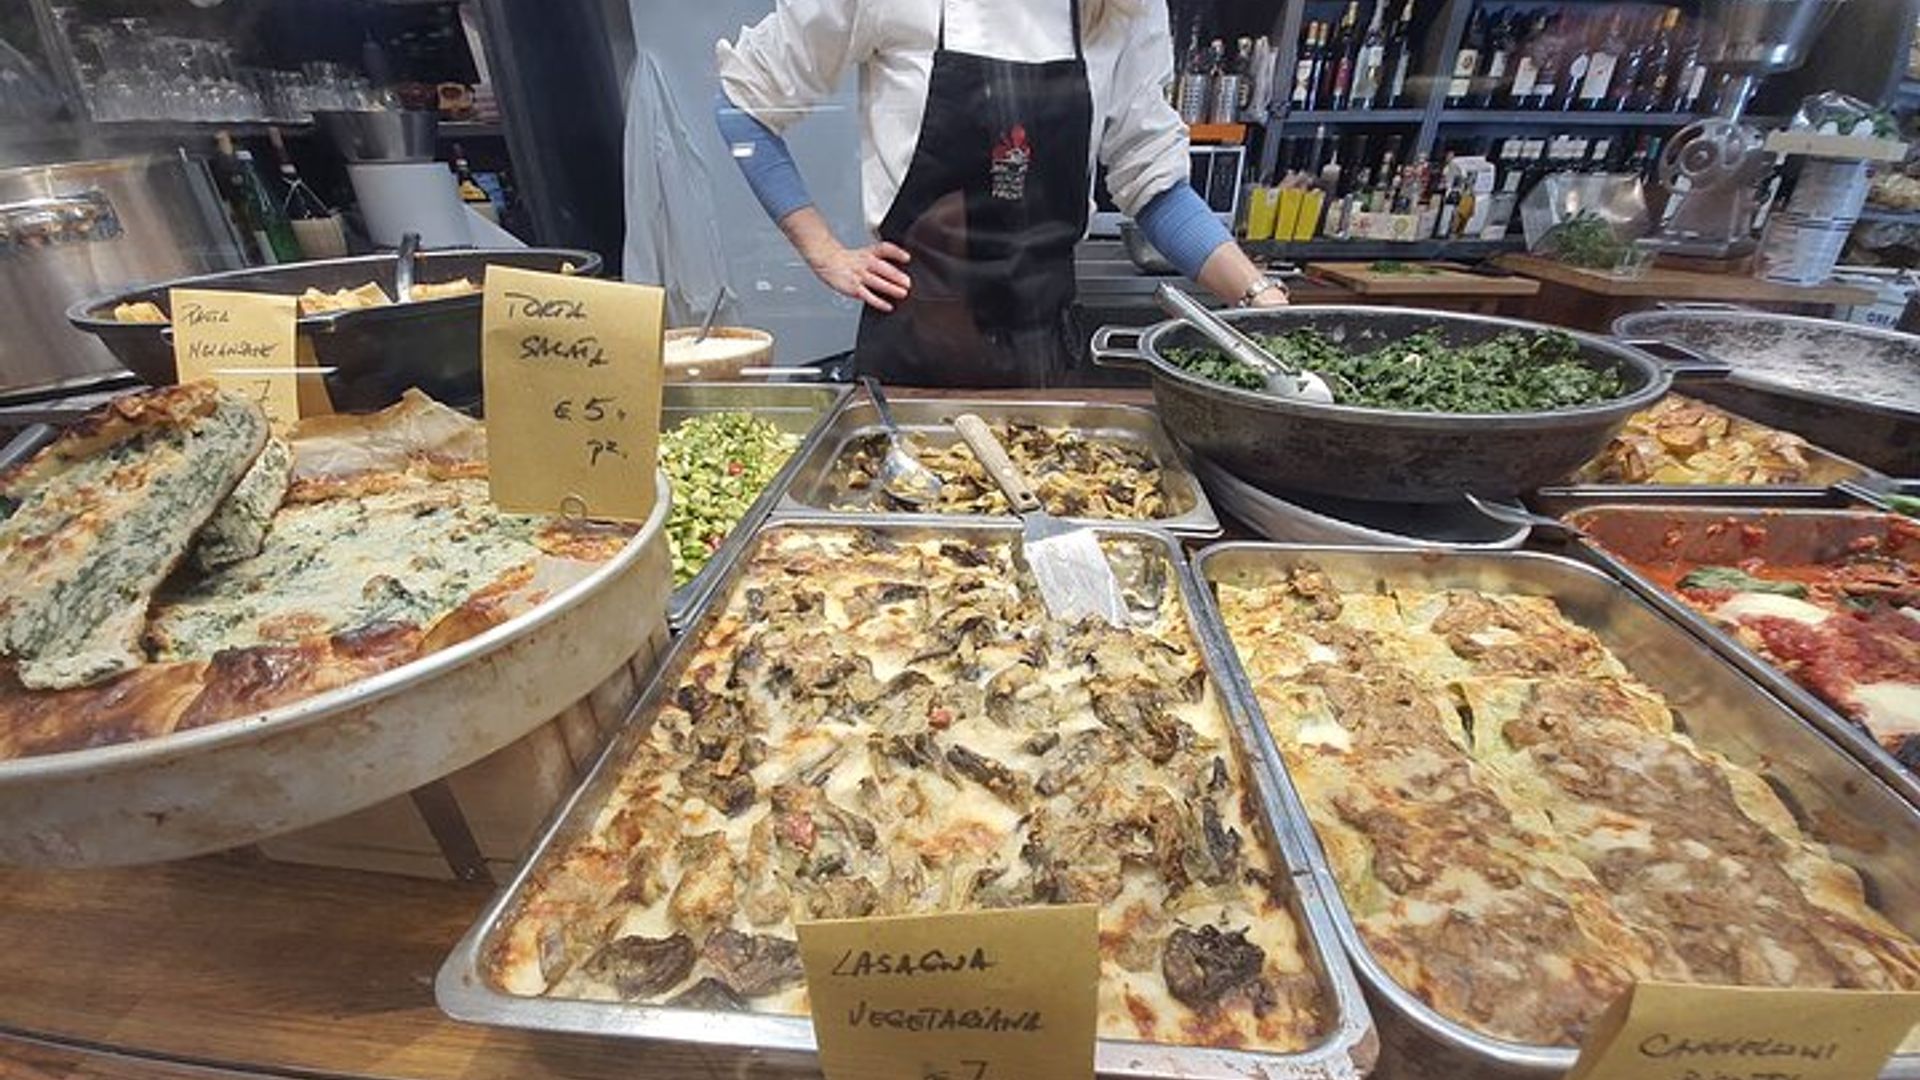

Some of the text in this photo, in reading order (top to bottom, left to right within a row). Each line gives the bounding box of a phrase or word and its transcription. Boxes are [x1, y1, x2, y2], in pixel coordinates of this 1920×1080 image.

[504, 291, 588, 320] TORTA
[832, 947, 1000, 978] LASAGNA
[847, 1001, 1044, 1032] VEGETARIANA
